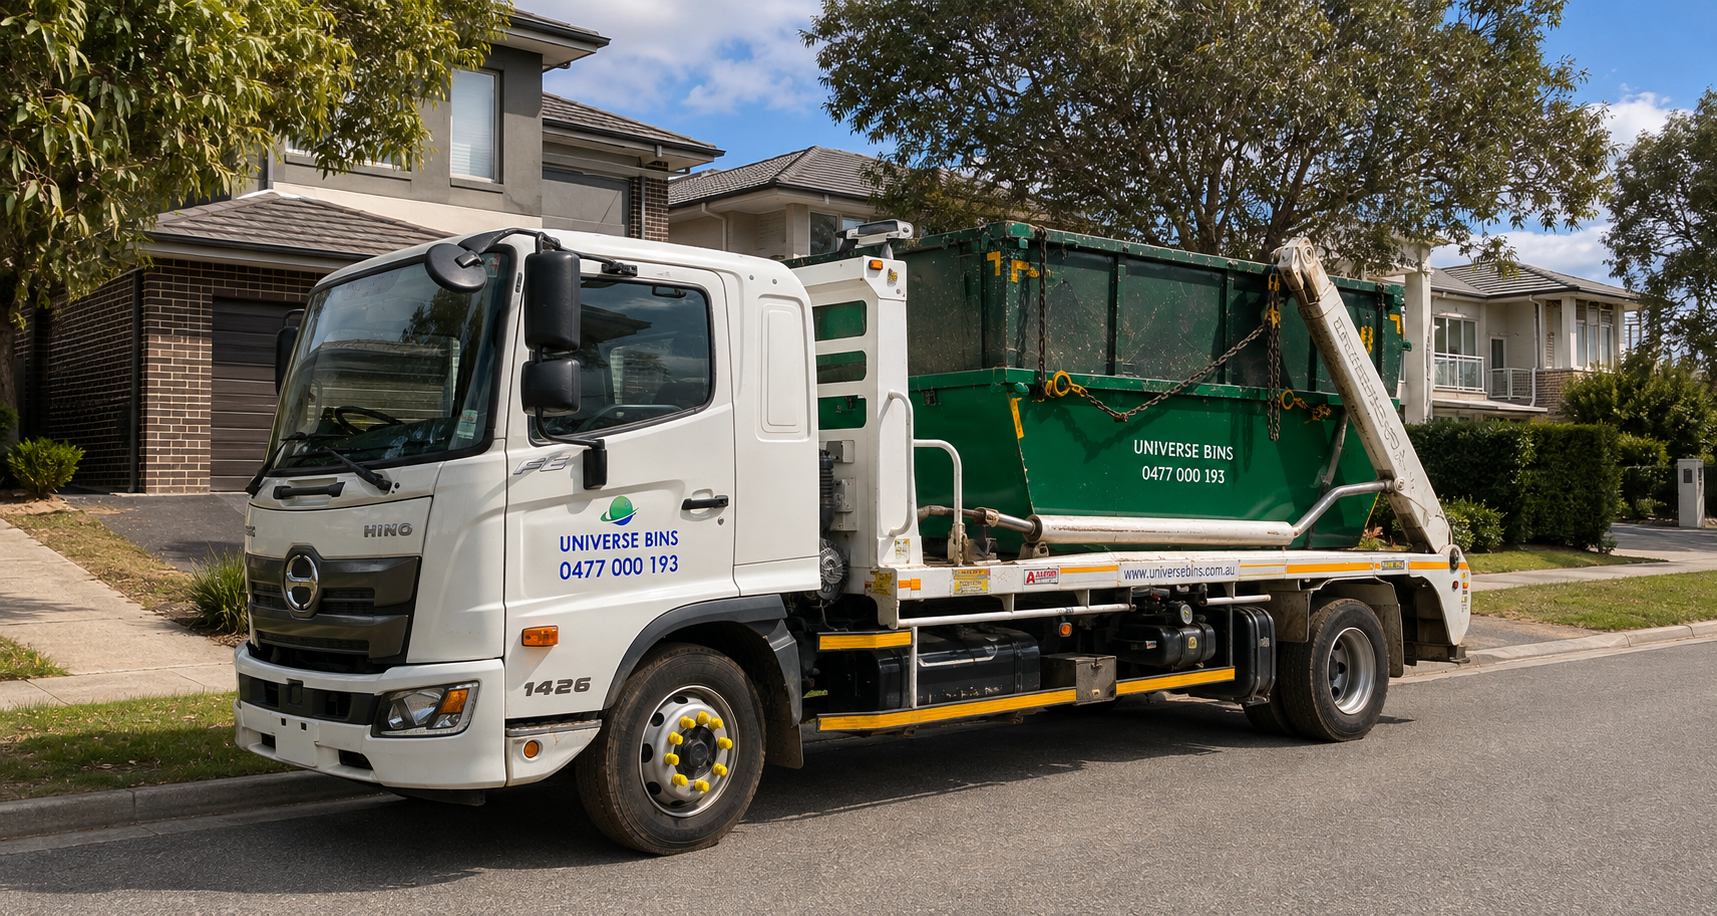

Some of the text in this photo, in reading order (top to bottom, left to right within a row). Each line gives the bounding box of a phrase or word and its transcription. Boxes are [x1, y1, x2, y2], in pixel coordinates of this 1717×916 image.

[1134, 439, 1234, 461] UNIVERSE BINS
[1142, 465, 1225, 484] 0477 000 193
[363, 522, 413, 538] HINO
[560, 530, 679, 552] UNIVERSE BINS
[560, 554, 679, 580] 0477 000 193
[1123, 565, 1236, 580] www.universebins.com.au
[523, 676, 592, 697] 1426
